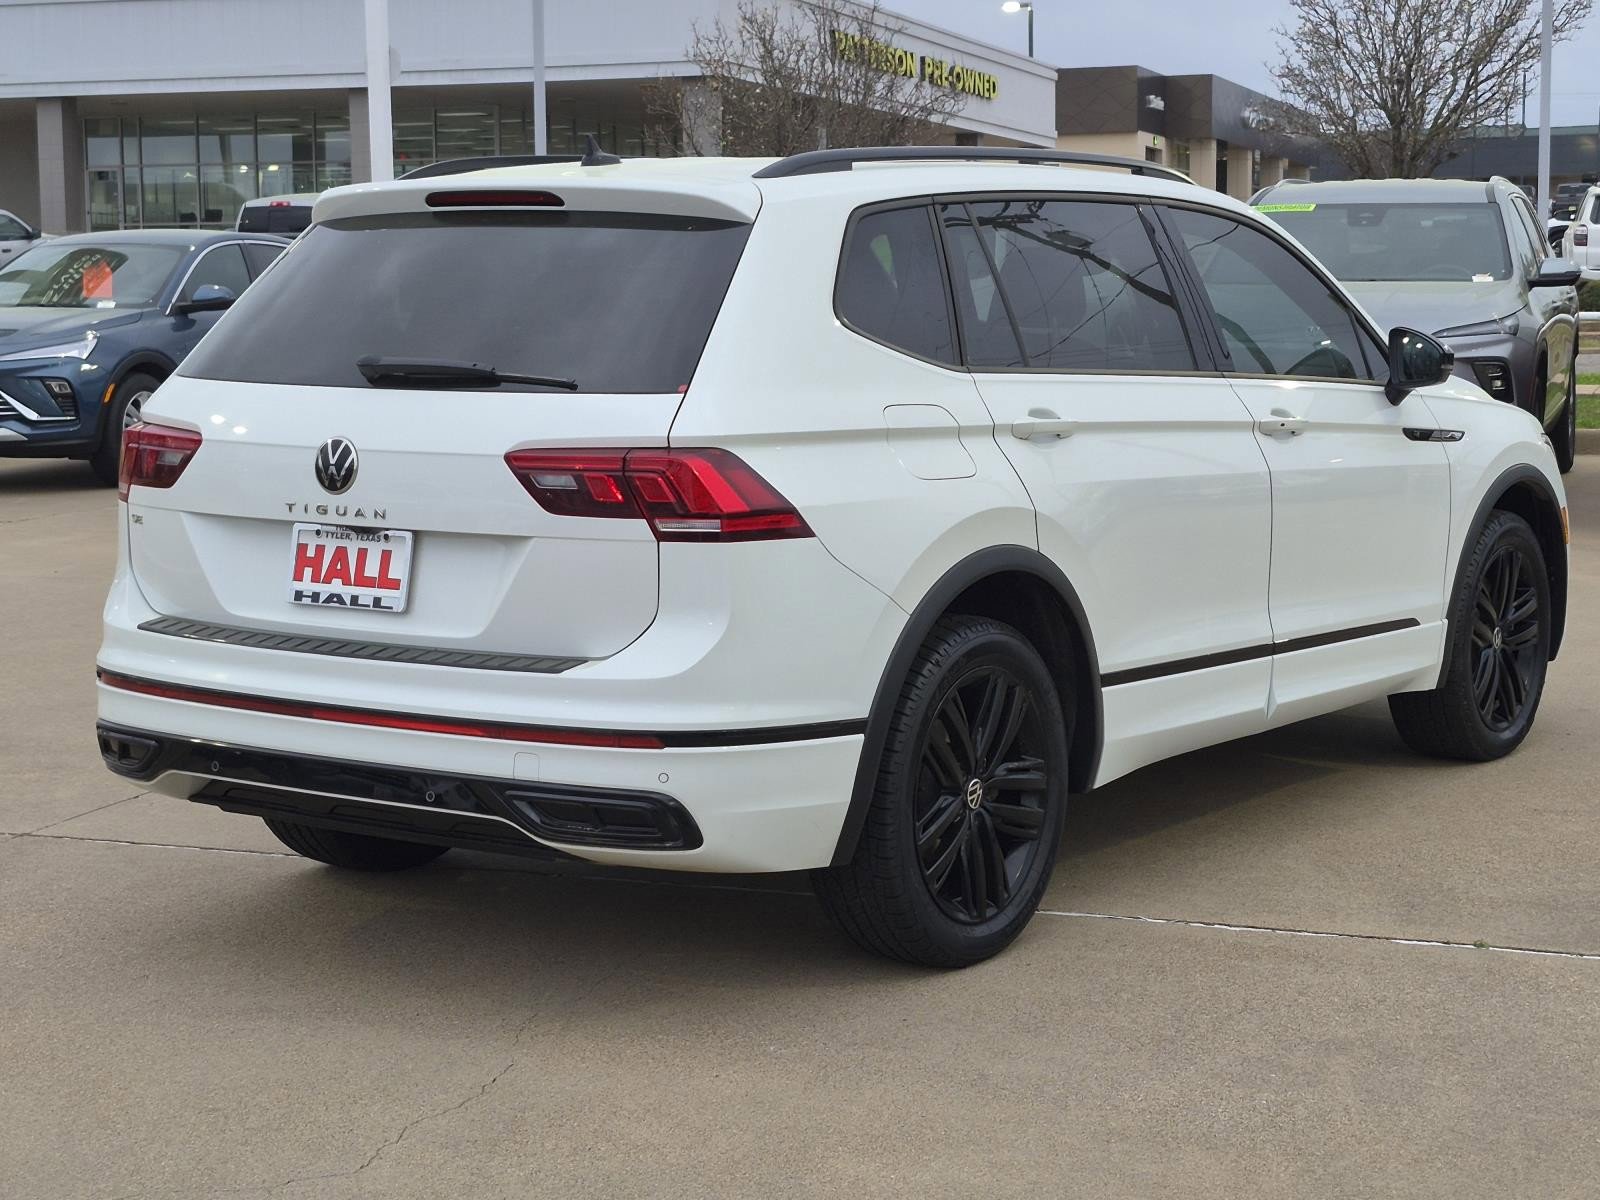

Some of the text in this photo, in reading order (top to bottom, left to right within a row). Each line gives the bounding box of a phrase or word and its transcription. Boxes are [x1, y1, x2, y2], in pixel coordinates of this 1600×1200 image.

[832, 31, 999, 99] PAERSON PRE-OWNED
[285, 502, 388, 520] TIGUAN
[325, 531, 382, 543] TYLER, TEXAS
[293, 542, 402, 591] HALL
[293, 590, 394, 610] HALL
